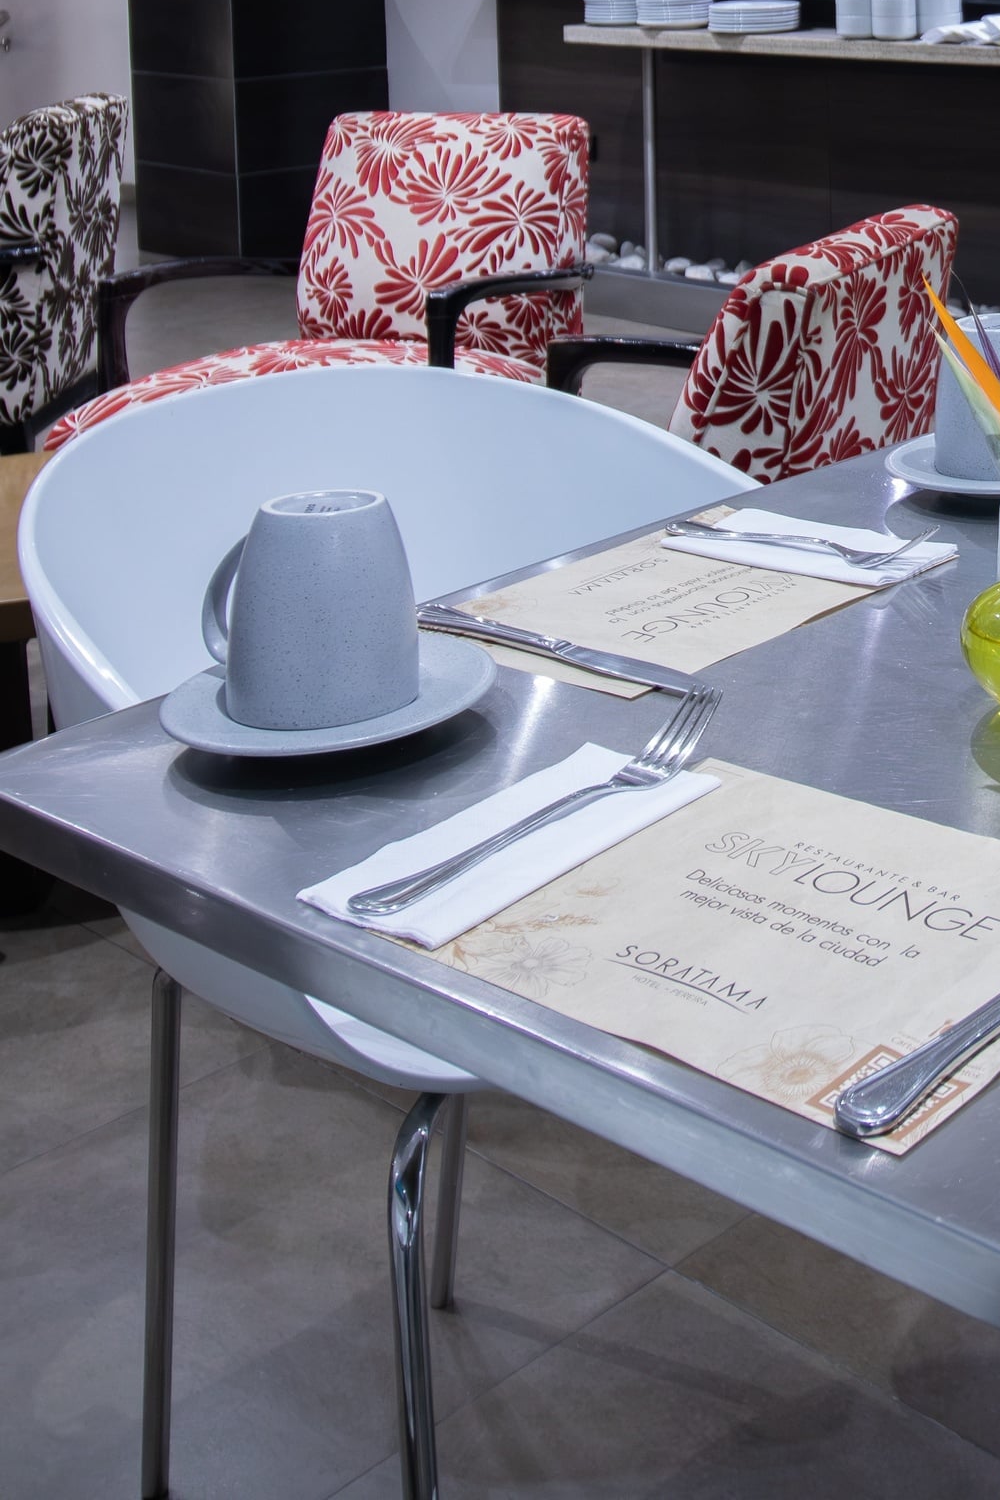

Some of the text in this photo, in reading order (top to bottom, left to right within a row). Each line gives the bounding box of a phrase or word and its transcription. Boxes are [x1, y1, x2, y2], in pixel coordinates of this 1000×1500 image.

[567, 557, 668, 596] SORATAMA
[793, 841, 909, 884] RESTAURANTE
[927, 885, 961, 902] BAR
[679, 889, 889, 968] mejor vista de la ciudad
[685, 868, 921, 960] Deliciosos momentos con la
[615, 944, 768, 1010] SORATAMA
